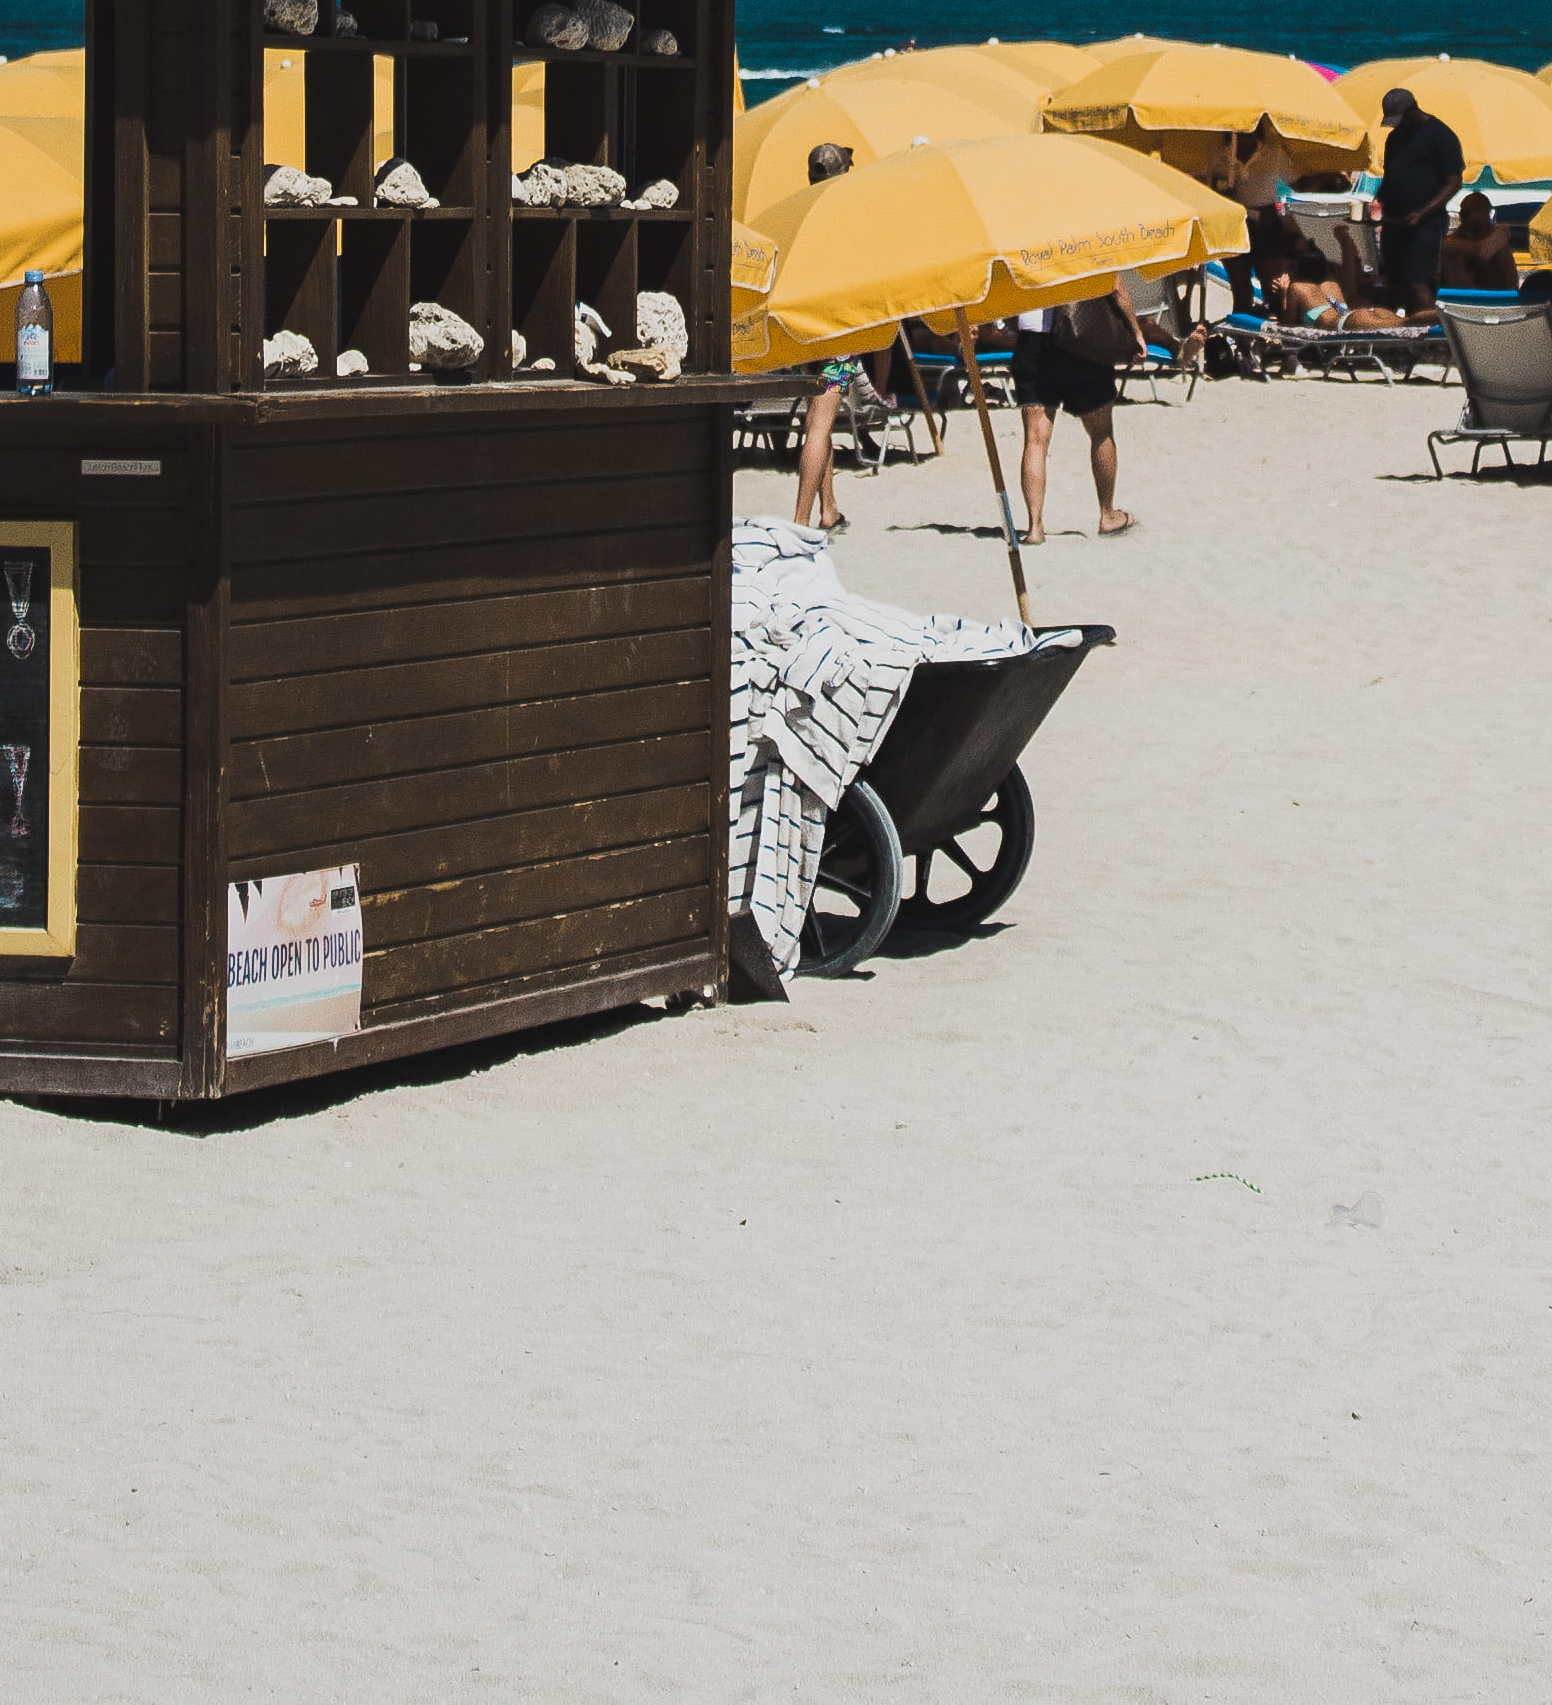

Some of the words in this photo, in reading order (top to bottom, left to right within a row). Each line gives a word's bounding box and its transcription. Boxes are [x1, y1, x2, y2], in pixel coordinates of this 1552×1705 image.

[1056, 234, 1092, 257] Palm
[1096, 225, 1136, 248] South
[1137, 219, 1176, 241] Beach
[227, 946, 269, 988] BEACH
[271, 939, 302, 980] OPEN
[305, 936, 320, 973] TO
[323, 927, 362, 971] PUBLIC
